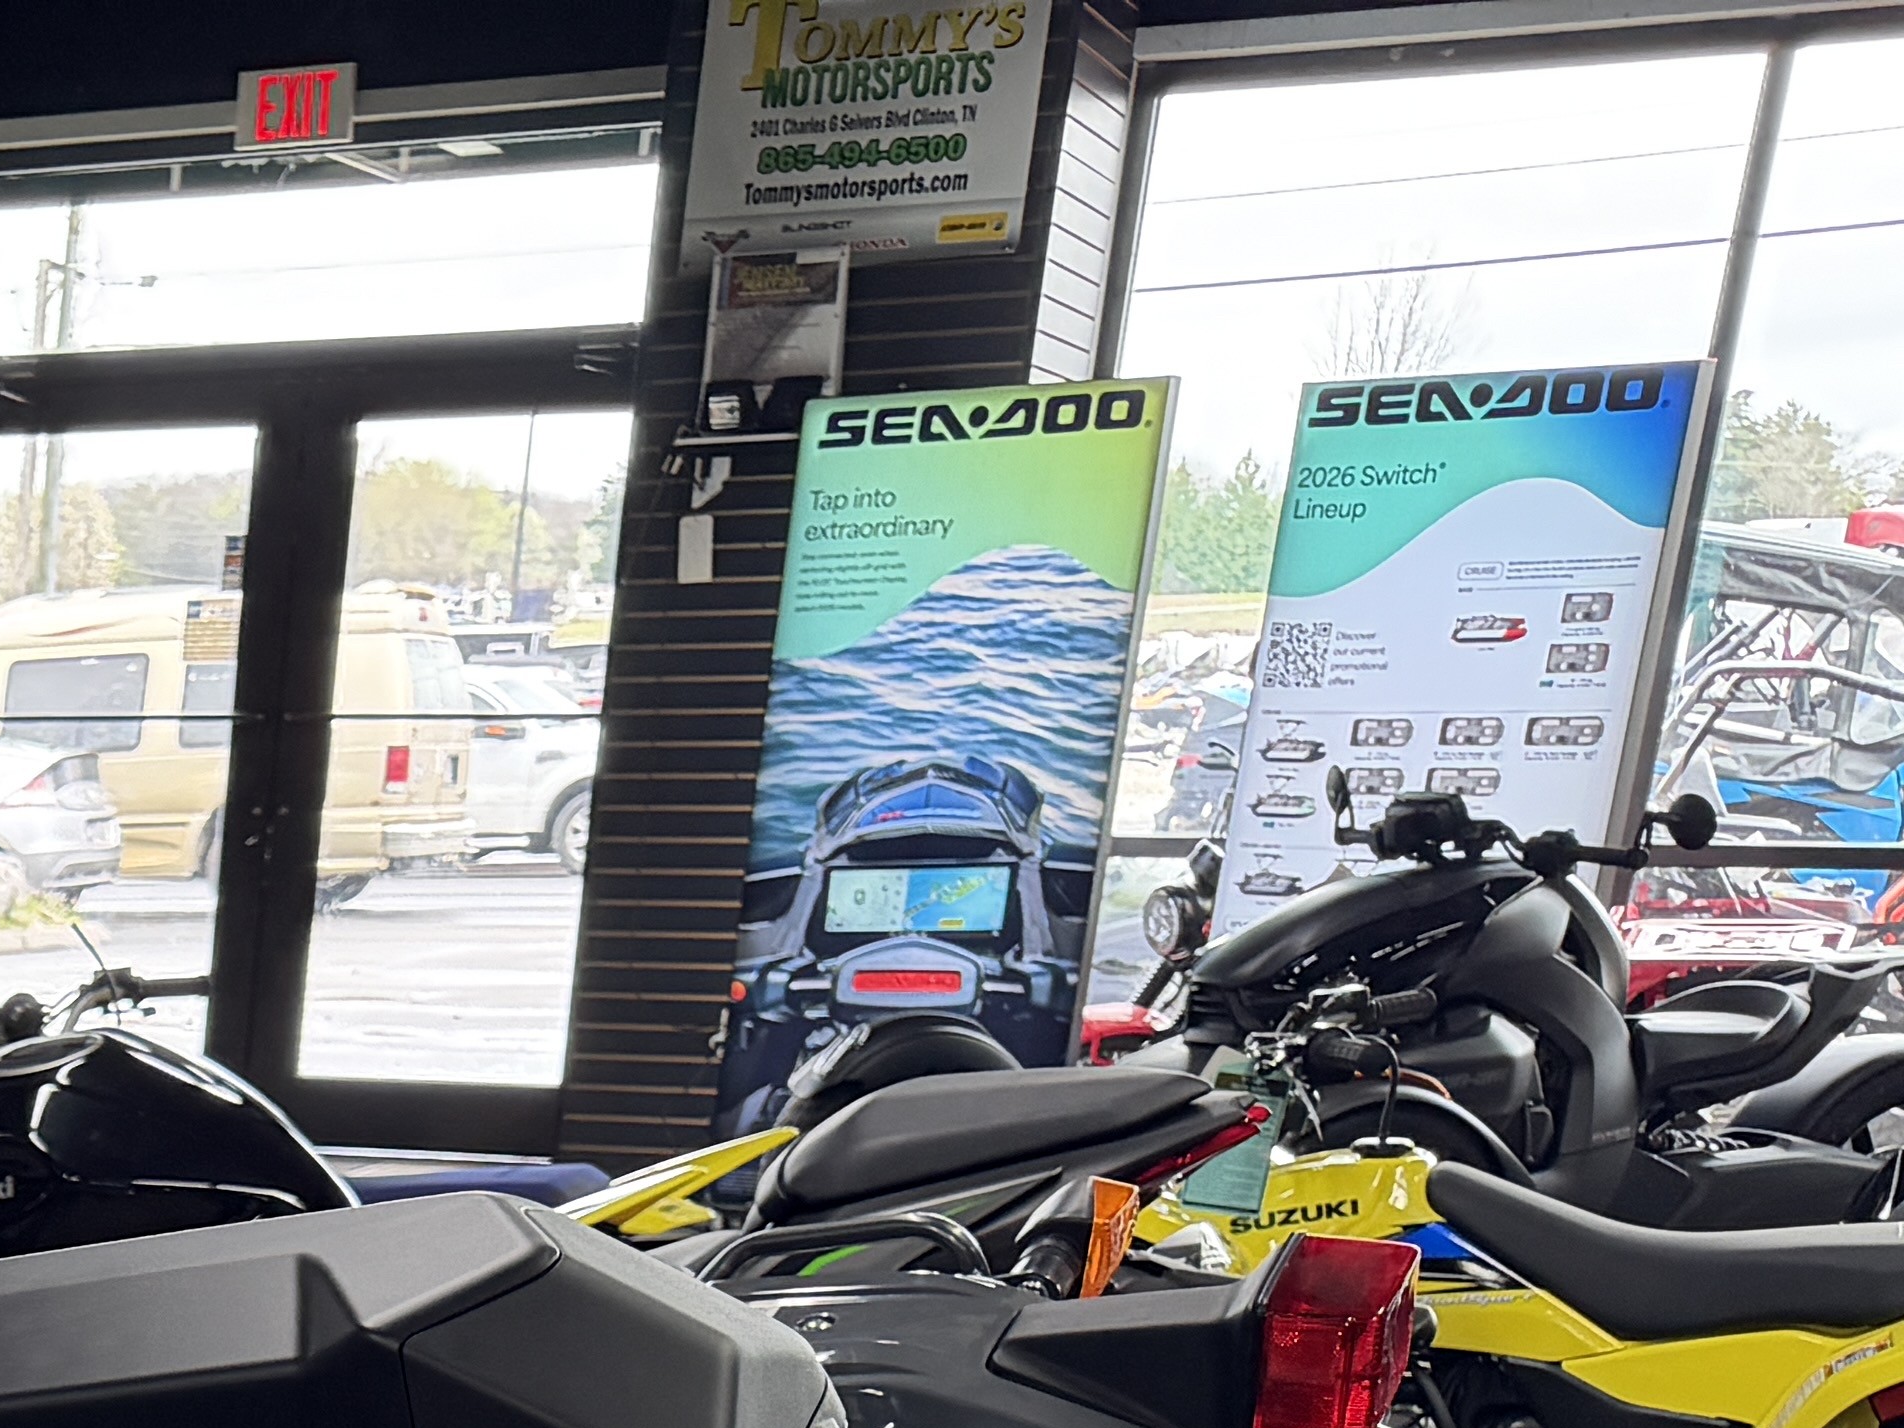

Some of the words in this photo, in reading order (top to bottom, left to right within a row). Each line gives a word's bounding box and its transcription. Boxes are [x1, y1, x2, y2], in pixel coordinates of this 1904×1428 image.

[728, 0, 1026, 91] TOMMY'S
[760, 51, 995, 108] MOTORSPORTS
[255, 69, 339, 141] EXIT
[884, 109, 911, 128] Blvd
[961, 104, 978, 122] TN
[757, 133, 968, 174] 865-494-6500
[744, 172, 969, 207] Tommysmotorsports.com
[1297, 465, 1356, 489] 2026
[810, 489, 849, 513] Tap
[853, 487, 898, 508] into
[1293, 499, 1367, 523] Lineup
[804, 515, 955, 542] extraordinary
[1229, 1199, 1360, 1235] SUZUKI
